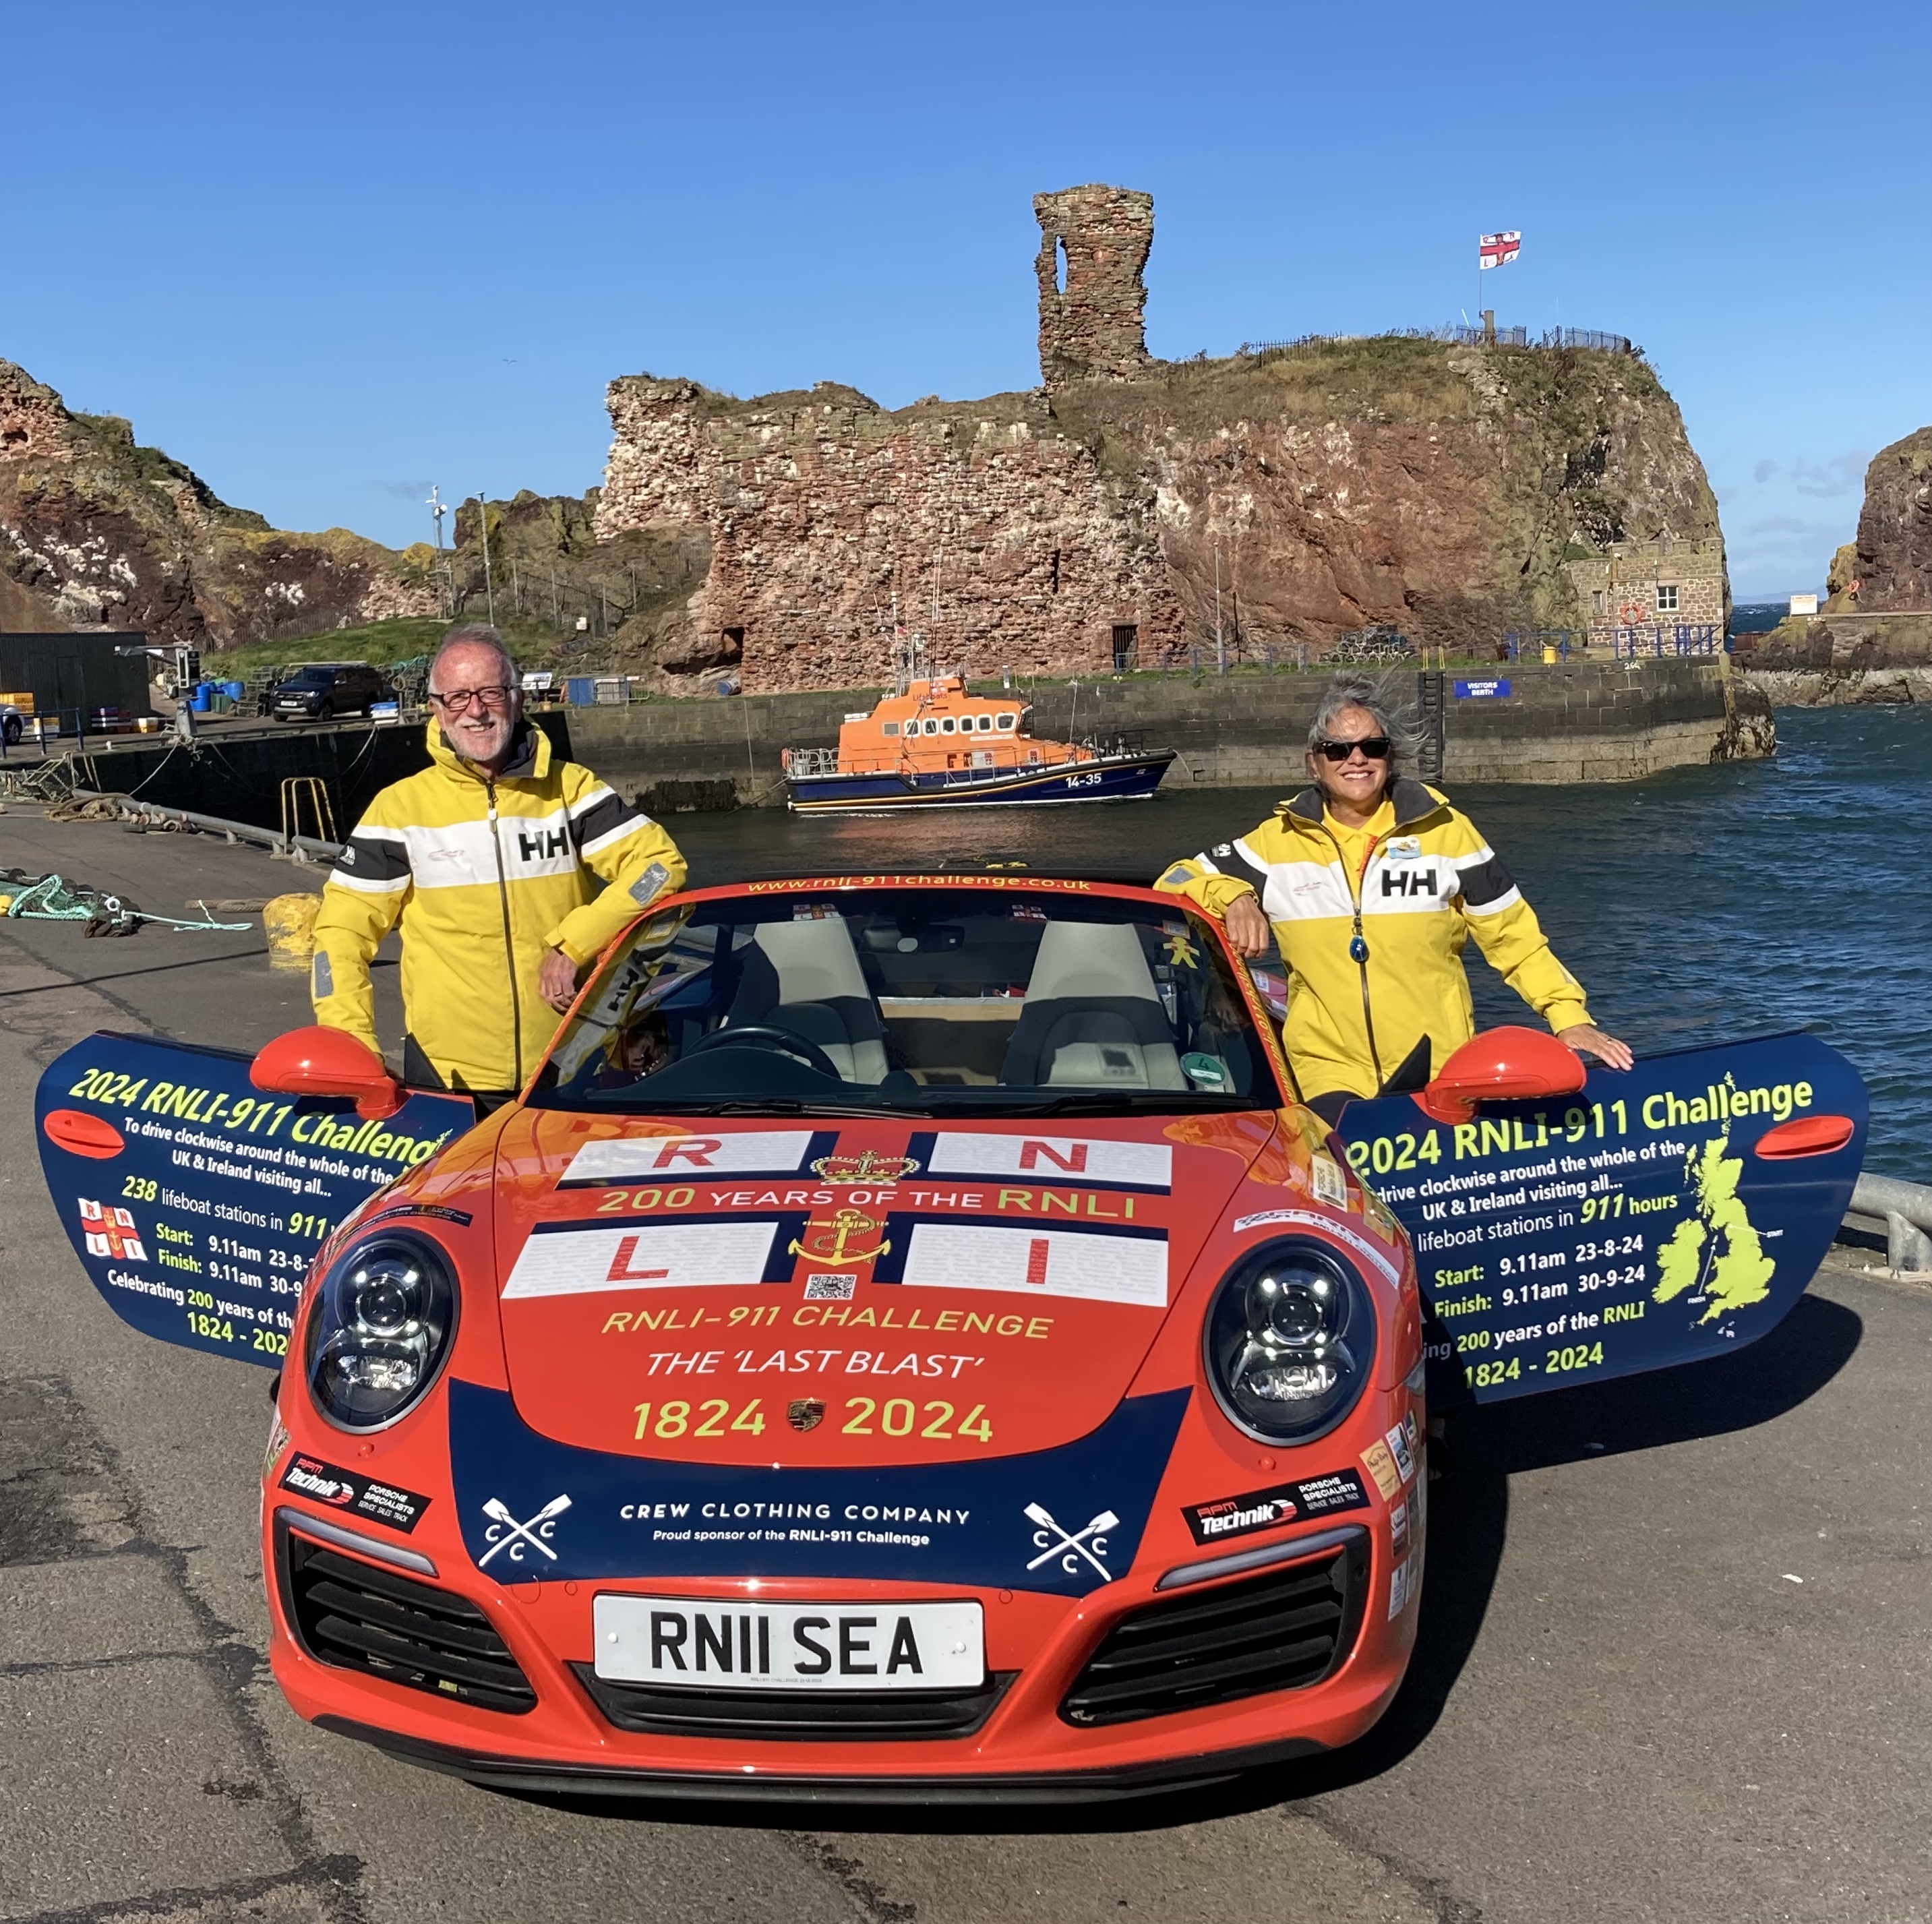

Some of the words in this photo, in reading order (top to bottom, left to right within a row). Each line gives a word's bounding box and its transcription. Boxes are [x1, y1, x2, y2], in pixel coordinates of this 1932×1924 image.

[1467, 682, 1499, 690] VISITORS
[1471, 688, 1495, 696] BERTH
[1066, 773, 1102, 788] 14-35
[518, 826, 571, 862] HH
[748, 876, 1090, 893] www.rnli-911challenge.co.uk
[1381, 868, 1438, 897] HH
[69, 1069, 148, 1104] 2024
[140, 1081, 293, 1135] RNLI-911
[1453, 1100, 1627, 1162] RNLI-911
[1643, 1081, 1813, 1131] Challenge
[124, 1117, 139, 1134] To
[142, 1121, 171, 1141] drive
[175, 1129, 233, 1153] clockwise
[236, 1140, 281, 1160] around
[285, 1148, 306, 1167] the
[309, 1156, 349, 1177] whole
[353, 1164, 371, 1180] of
[652, 1139, 722, 1168] R
[1019, 1141, 1088, 1172] N
[173, 1150, 191, 1166] UK
[193, 1153, 204, 1170] &
[207, 1156, 251, 1178] Ireland
[254, 1169, 301, 1195] visiting
[303, 1178, 332, 1197] all...
[1377, 1184, 1416, 1204] drive
[1420, 1172, 1496, 1197] clockwise
[1499, 1164, 1557, 1186] around
[1561, 1155, 1586, 1174] the
[1590, 1148, 1637, 1168] whole
[1640, 1144, 1658, 1159] of
[1659, 1139, 1685, 1156] the
[86, 1203, 96, 1217] R
[119, 1211, 129, 1224] N
[122, 1176, 157, 1202] 238
[162, 1189, 210, 1213] lifeboat
[214, 1203, 266, 1228] stations
[270, 1214, 282, 1230] in
[289, 1213, 325, 1239] 911
[596, 1187, 696, 1213] 200
[710, 1191, 832, 1207] YEARS
[849, 1191, 904, 1206] OF
[914, 1191, 982, 1209] THE
[996, 1189, 1135, 1219] RNLI
[1422, 1201, 1447, 1221] UK
[1450, 1199, 1466, 1215] &
[1469, 1191, 1526, 1213] Ireland
[1530, 1182, 1588, 1207] visiting
[1591, 1178, 1623, 1196] all...
[1418, 1222, 1483, 1253] lifeboat
[1486, 1215, 1555, 1241] stations
[1559, 1210, 1574, 1226] in
[1579, 1195, 1625, 1224] 911
[1629, 1195, 1679, 1215] hours
[94, 1238, 104, 1253] L
[156, 1223, 193, 1246] Start:
[208, 1236, 262, 1262] 9.11am
[158, 1249, 202, 1274] Finish:
[210, 1261, 262, 1289] 9.11am
[606, 1236, 669, 1282] L
[1025, 1238, 1050, 1284] I
[1435, 1265, 1485, 1288] Start:
[1499, 1250, 1566, 1275] 9.11am
[1575, 1235, 1644, 1263] 23-8-24
[108, 1269, 184, 1304] Celebrating
[187, 1289, 214, 1310] 200
[217, 1299, 254, 1322] years
[258, 1309, 276, 1323] of
[1435, 1295, 1492, 1319] Finish:
[1502, 1281, 1568, 1306] 9.11am
[1577, 1265, 1646, 1293] 30-9-24
[187, 1311, 233, 1344] 1824
[601, 1306, 780, 1334] RNLI-911
[791, 1306, 1054, 1340] CHALLENGE
[1457, 1331, 1490, 1353] 200
[1494, 1321, 1543, 1348] years
[1546, 1316, 1567, 1334] of
[1569, 1311, 1600, 1330] the
[1604, 1301, 1645, 1326] RNLI
[645, 1352, 719, 1376] THE
[1465, 1355, 1521, 1387] 1824
[1546, 1343, 1604, 1373] 2024
[632, 1398, 767, 1439] 1824
[841, 1397, 993, 1442] 2024
[285, 1467, 340, 1497] Technik
[296, 1457, 324, 1474] RPM
[368, 1484, 408, 1503] PORSCHE
[1298, 1476, 1341, 1493] PORSCHE
[1303, 1482, 1358, 1502] SPECIALISTS
[363, 1492, 415, 1515] SPECIALISTS
[620, 1503, 690, 1519] CREW
[701, 1503, 831, 1519] CLOTHING
[845, 1505, 971, 1525] COMPANY
[1197, 1501, 1238, 1517] RPM
[1201, 1504, 1275, 1535] Technik
[653, 1530, 690, 1540] Proud
[694, 1531, 745, 1542] sponsor
[748, 1530, 762, 1540] of
[764, 1530, 786, 1540] the
[789, 1530, 852, 1542] RNLI-911
[856, 1531, 930, 1546] Challenge
[793, 1616, 924, 1675] SEA
